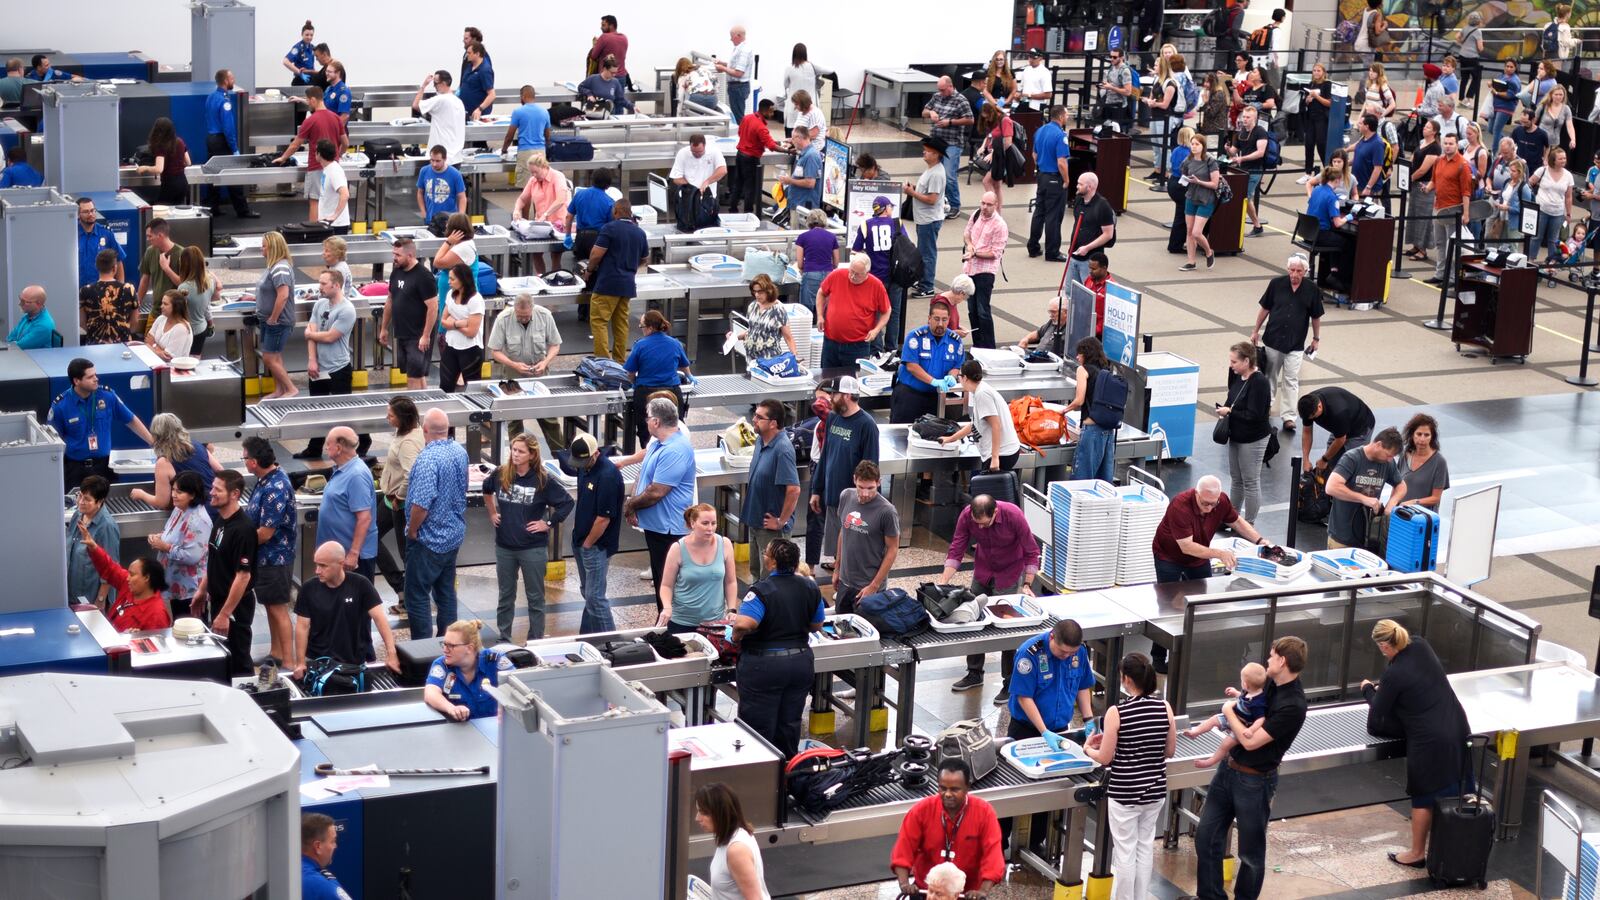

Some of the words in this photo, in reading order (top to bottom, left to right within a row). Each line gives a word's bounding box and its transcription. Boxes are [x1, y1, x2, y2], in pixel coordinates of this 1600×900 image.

[871, 224, 892, 252] 18
[1107, 306, 1126, 321] HOLD
[1127, 314, 1134, 324] IT
